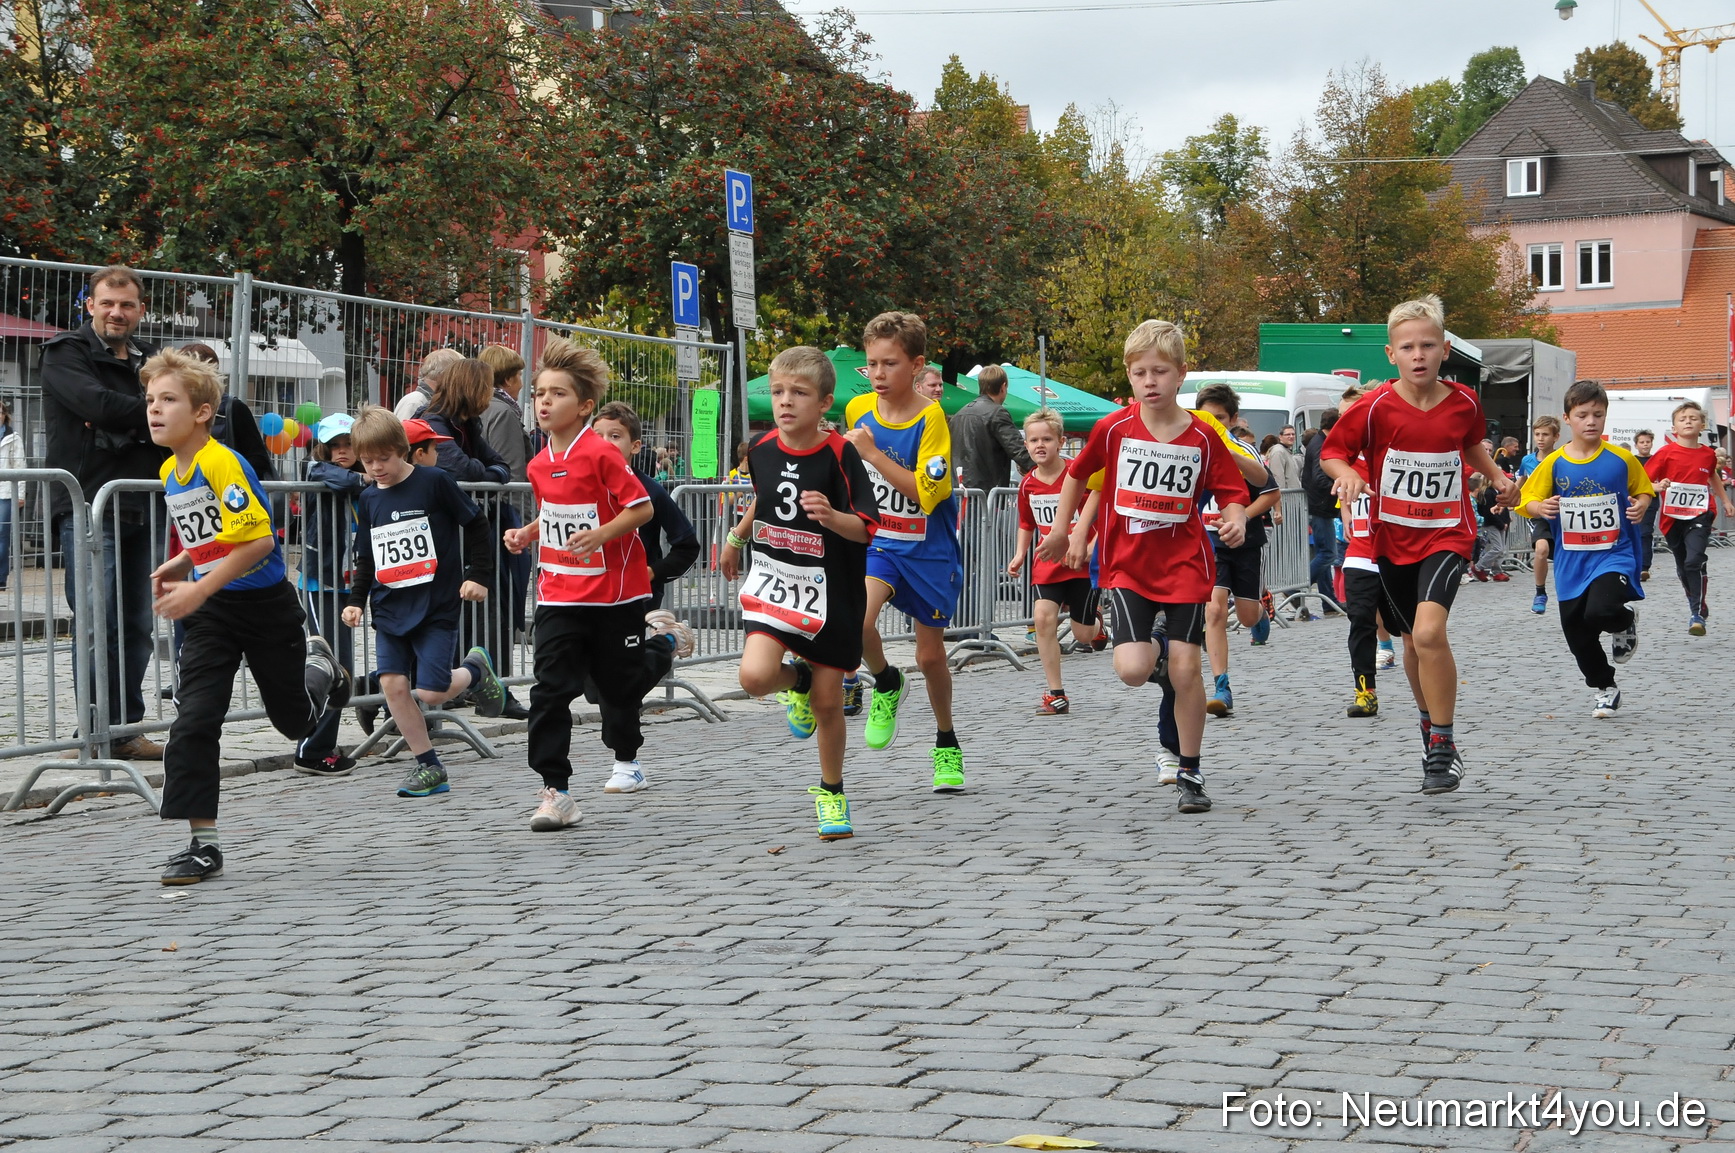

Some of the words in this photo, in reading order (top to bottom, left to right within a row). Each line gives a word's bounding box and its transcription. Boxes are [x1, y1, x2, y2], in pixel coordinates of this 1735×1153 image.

[731, 178, 747, 223] P
[732, 247, 752, 259] Parkschein
[734, 259, 751, 270] werktags
[678, 271, 693, 317] P
[1122, 445, 1148, 457] PARTL
[1150, 450, 1190, 462] Neumarkt
[1385, 455, 1412, 467] PARTL
[1414, 460, 1452, 468] Neumarkt
[1127, 458, 1193, 494] 7043
[1390, 468, 1457, 499] 7057
[172, 497, 206, 512] Neumarkt
[774, 481, 798, 521] 3
[876, 484, 921, 515] 209
[1135, 495, 1175, 511] Vincent
[1670, 491, 1706, 507] 7072
[552, 510, 585, 519] Neumarkt
[1407, 504, 1434, 517] Luca
[176, 505, 224, 543] 528
[230, 513, 257, 529] PARTL
[879, 516, 902, 530] iklas
[1565, 508, 1615, 530] 7153
[372, 532, 387, 541] PARTL
[387, 526, 419, 537] Neumarkt
[768, 527, 823, 547] Hundegitter24
[1580, 535, 1601, 543] Elias
[193, 545, 225, 561] Jonas
[378, 534, 429, 566] 7539
[809, 547, 821, 555] dog
[557, 553, 580, 565] Linus
[394, 567, 415, 577] Oskar
[776, 567, 811, 583] Neumarkt
[754, 572, 820, 614] 7512
